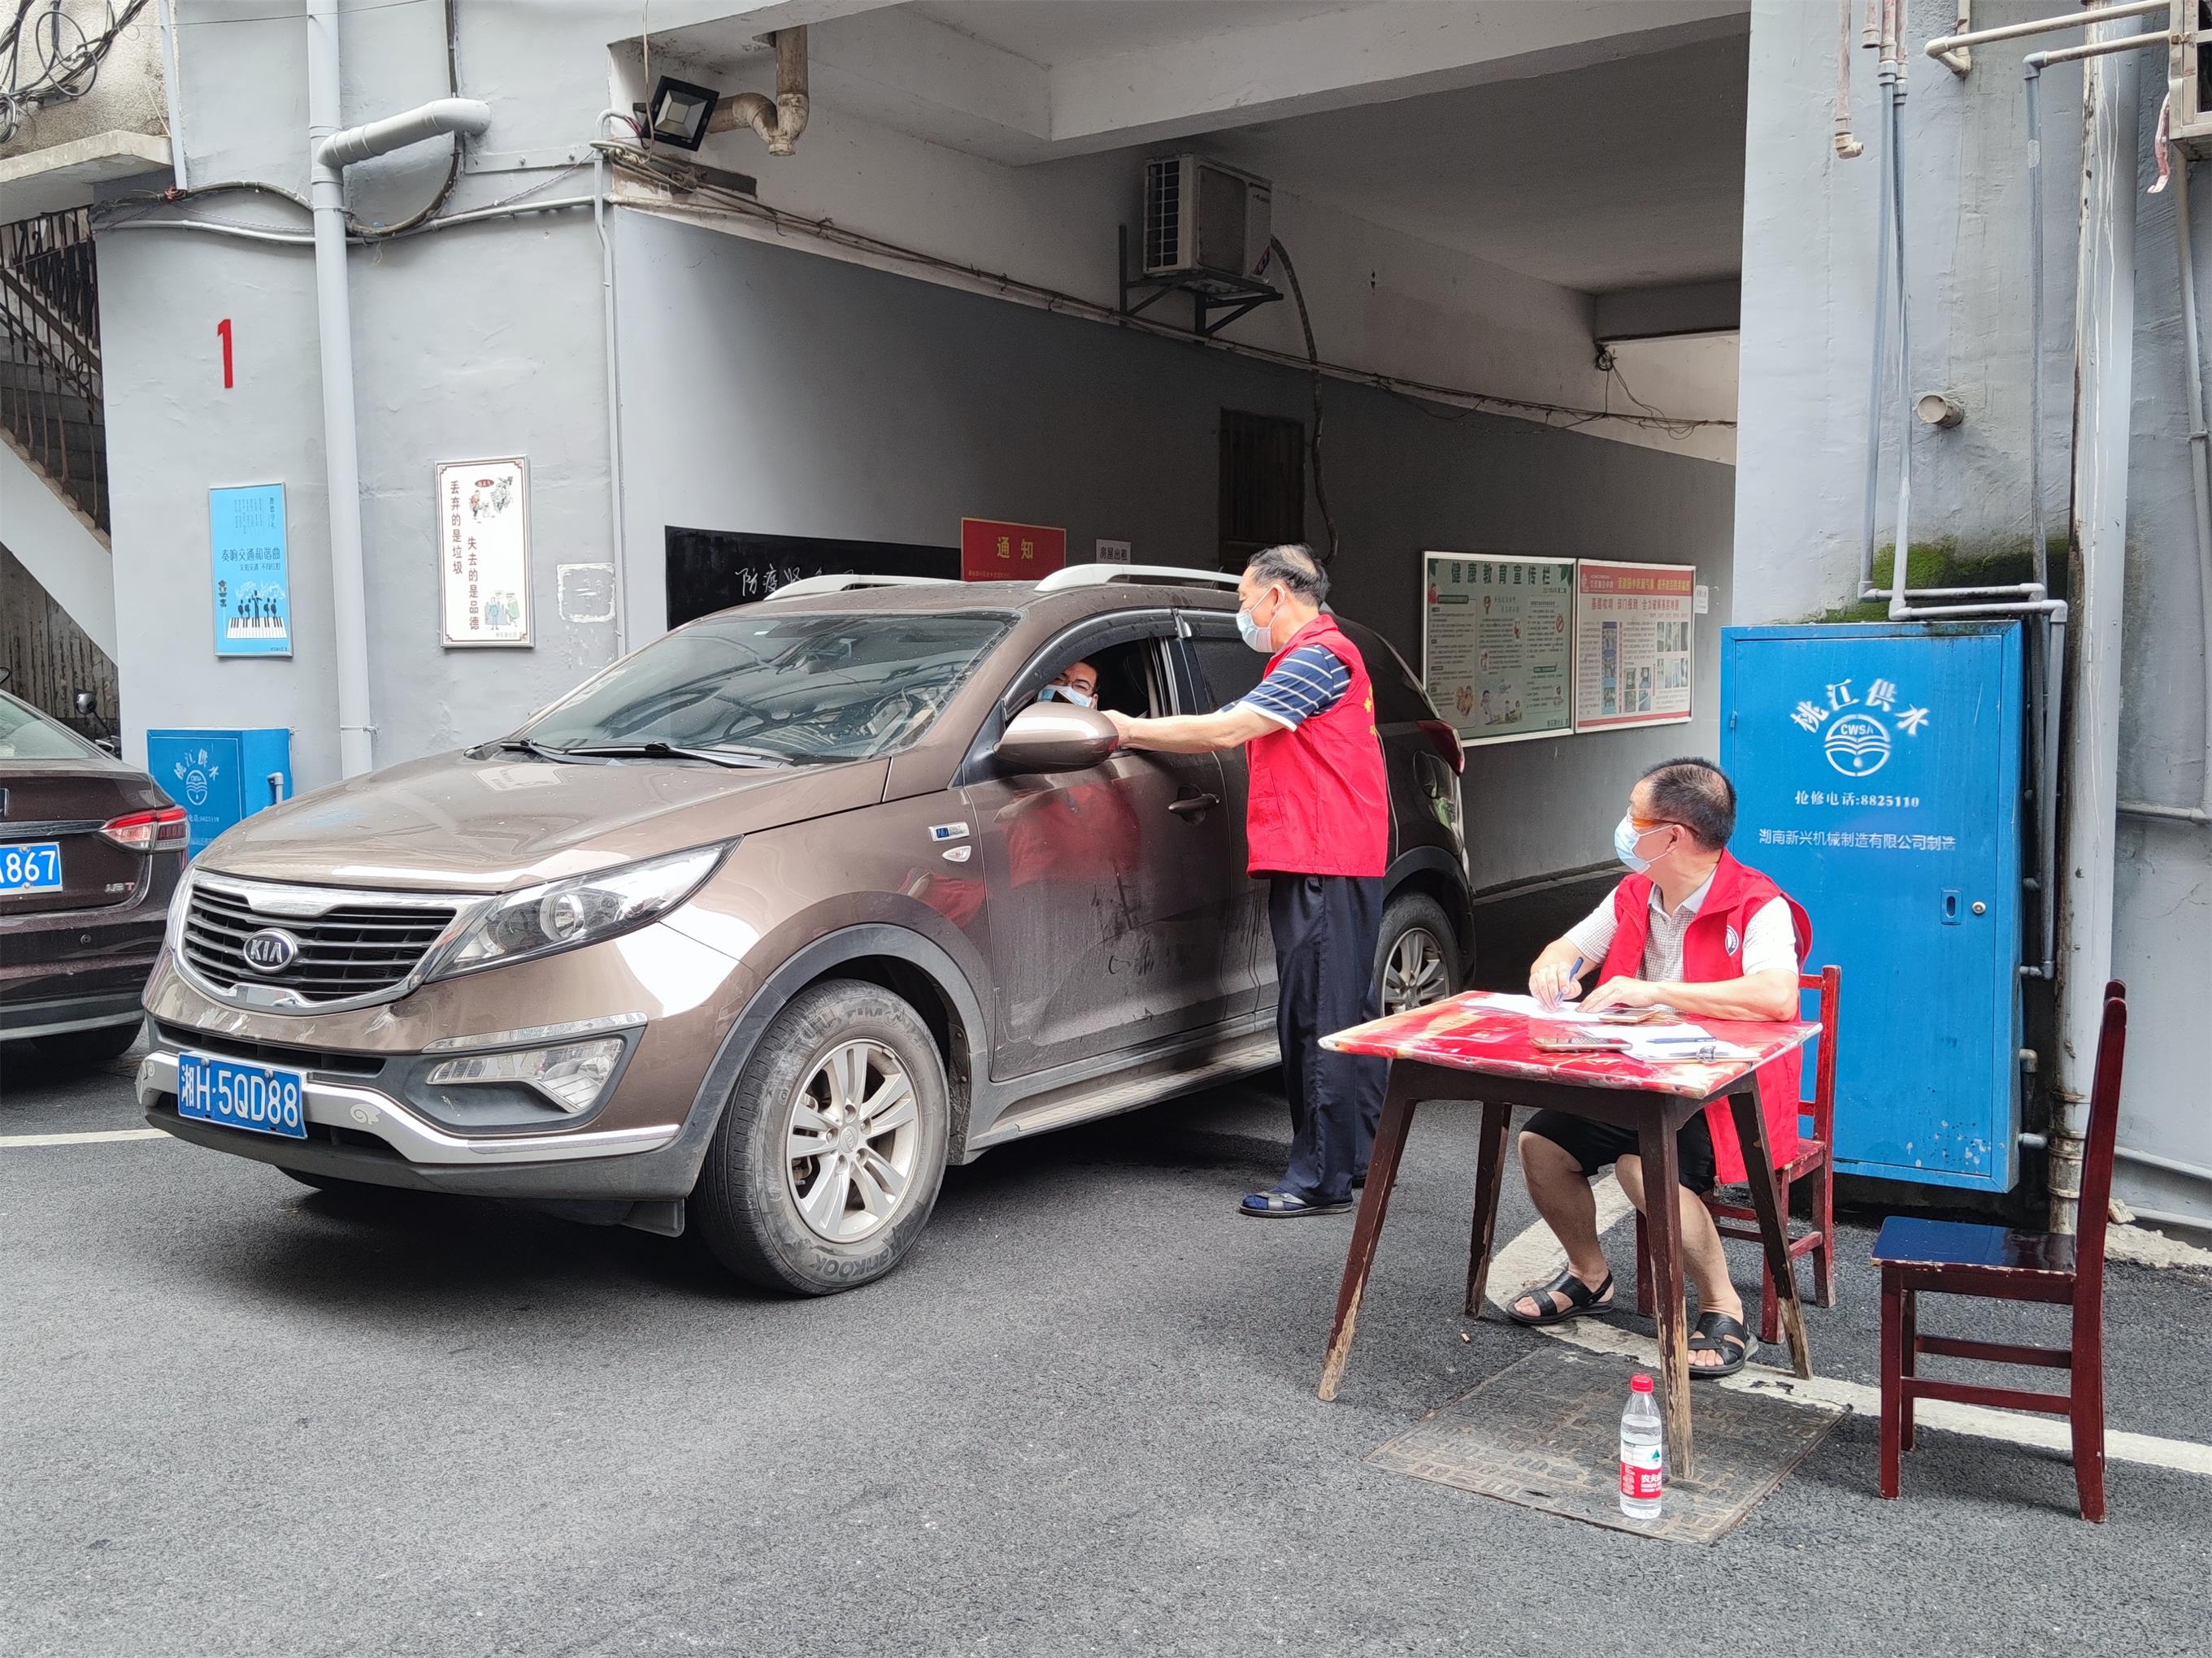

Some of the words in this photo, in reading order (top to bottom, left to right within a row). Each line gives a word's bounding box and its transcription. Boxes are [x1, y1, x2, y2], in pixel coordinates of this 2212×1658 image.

[217, 319, 233, 388] 1
[450, 480, 463, 575] 丢弃的是垃圾
[221, 547, 280, 562] 奏响交通和谐曲
[997, 536, 1034, 560] 通知
[467, 536, 480, 631] 失去的是品德
[1451, 561, 1551, 585] 健康教育宣传栏
[1790, 678, 1931, 737] 桃江供水
[1840, 724, 1875, 736] CWSA
[1759, 828, 1956, 851] 湖南新兴机械制造有限公司制造
[250, 939, 283, 963] KIA
